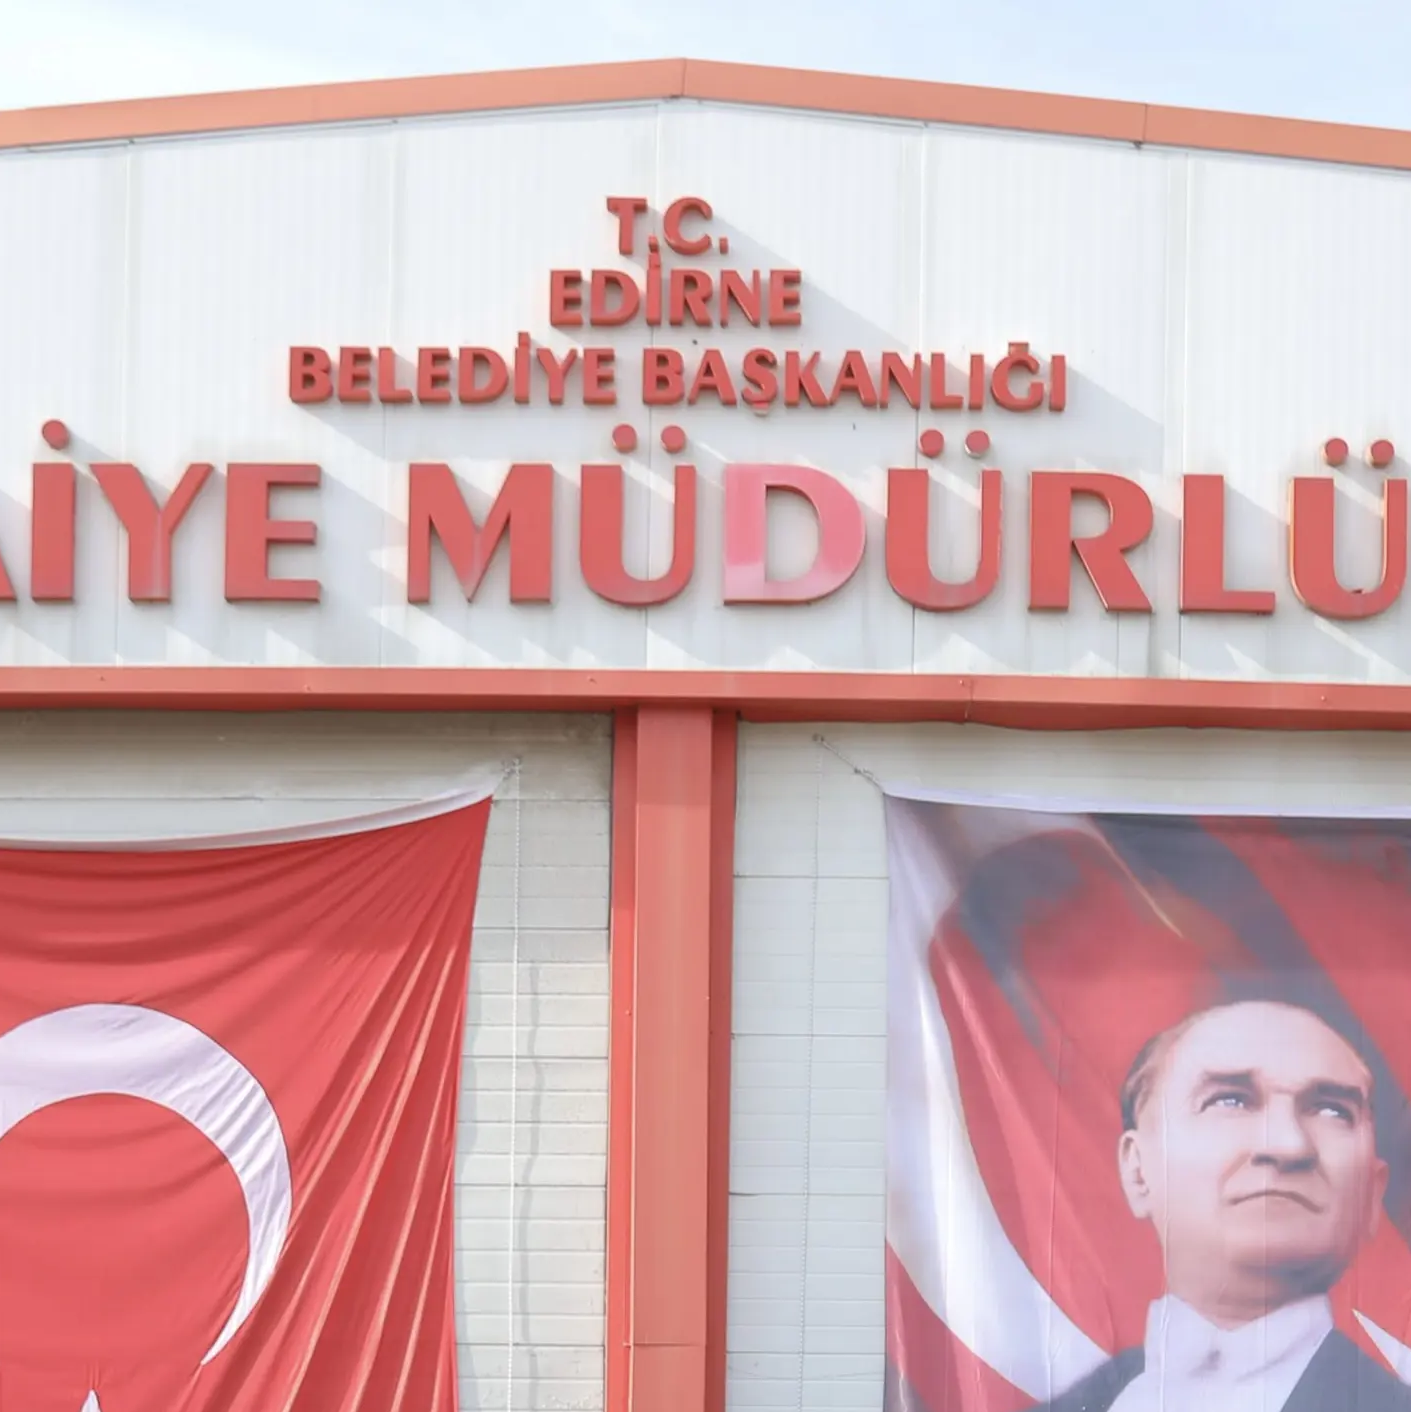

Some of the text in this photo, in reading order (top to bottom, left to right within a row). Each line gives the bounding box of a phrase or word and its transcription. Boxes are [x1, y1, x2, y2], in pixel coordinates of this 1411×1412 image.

[607, 196, 729, 256] T.C.
[549, 253, 803, 327] EDİRNE
[288, 331, 1068, 416] BELEDİYE BAŞKANLIĞI
